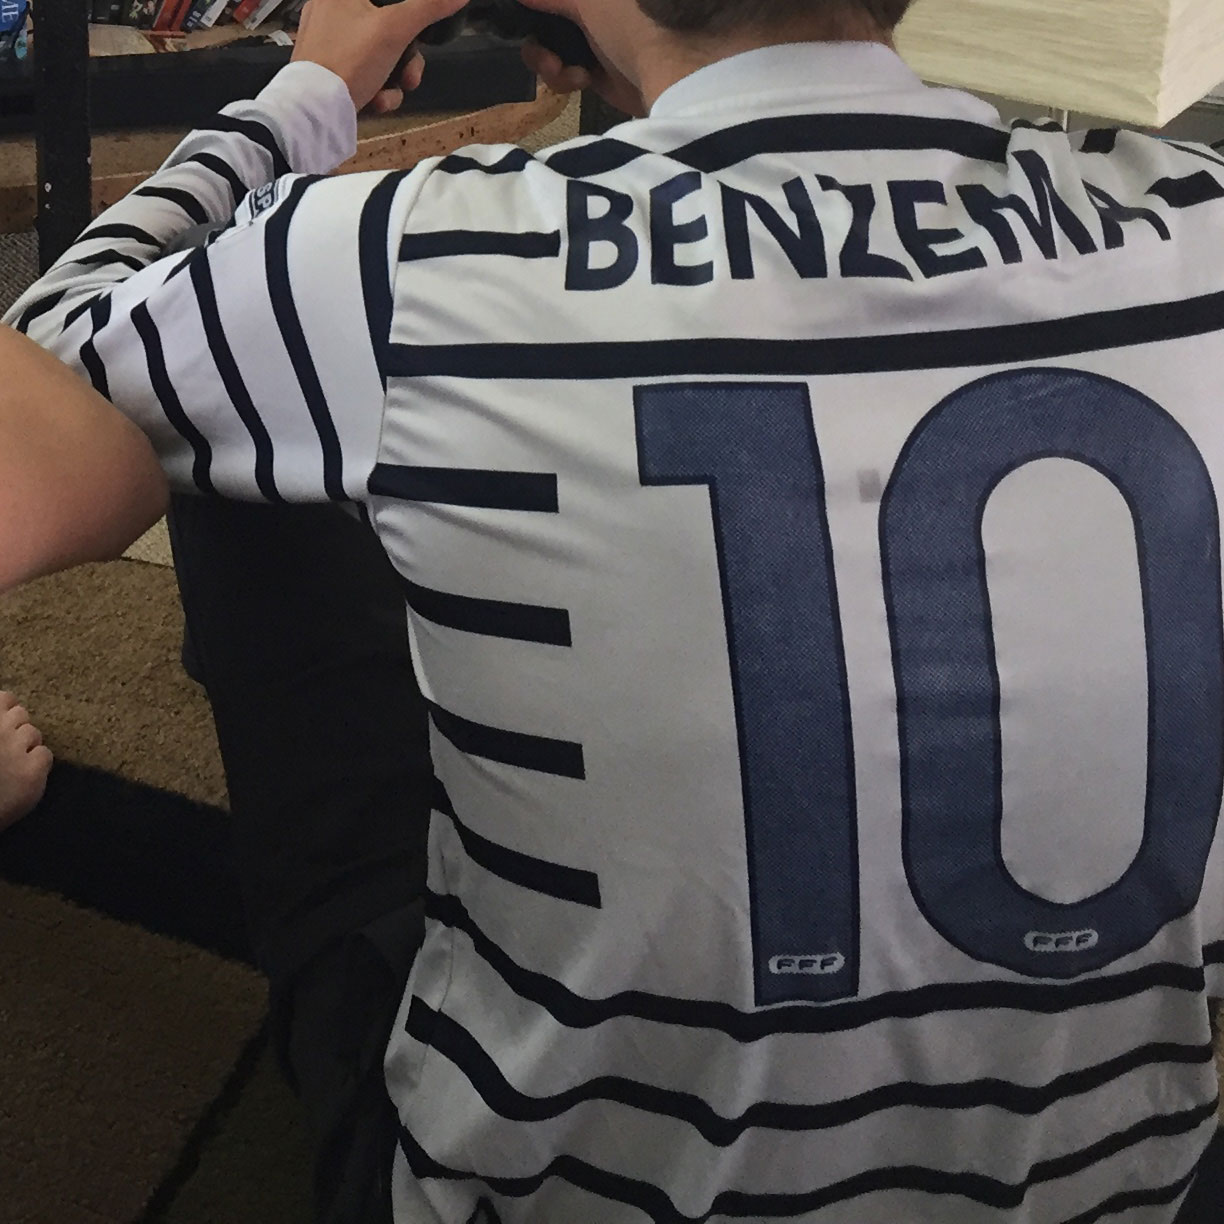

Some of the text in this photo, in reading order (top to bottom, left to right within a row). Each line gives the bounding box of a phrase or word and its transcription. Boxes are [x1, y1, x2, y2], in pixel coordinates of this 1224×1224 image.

[565, 149, 1171, 291] BENZEMA
[632, 366, 1222, 1007] 10
[776, 955, 838, 971] FFF
[1030, 932, 1093, 949] FFF
